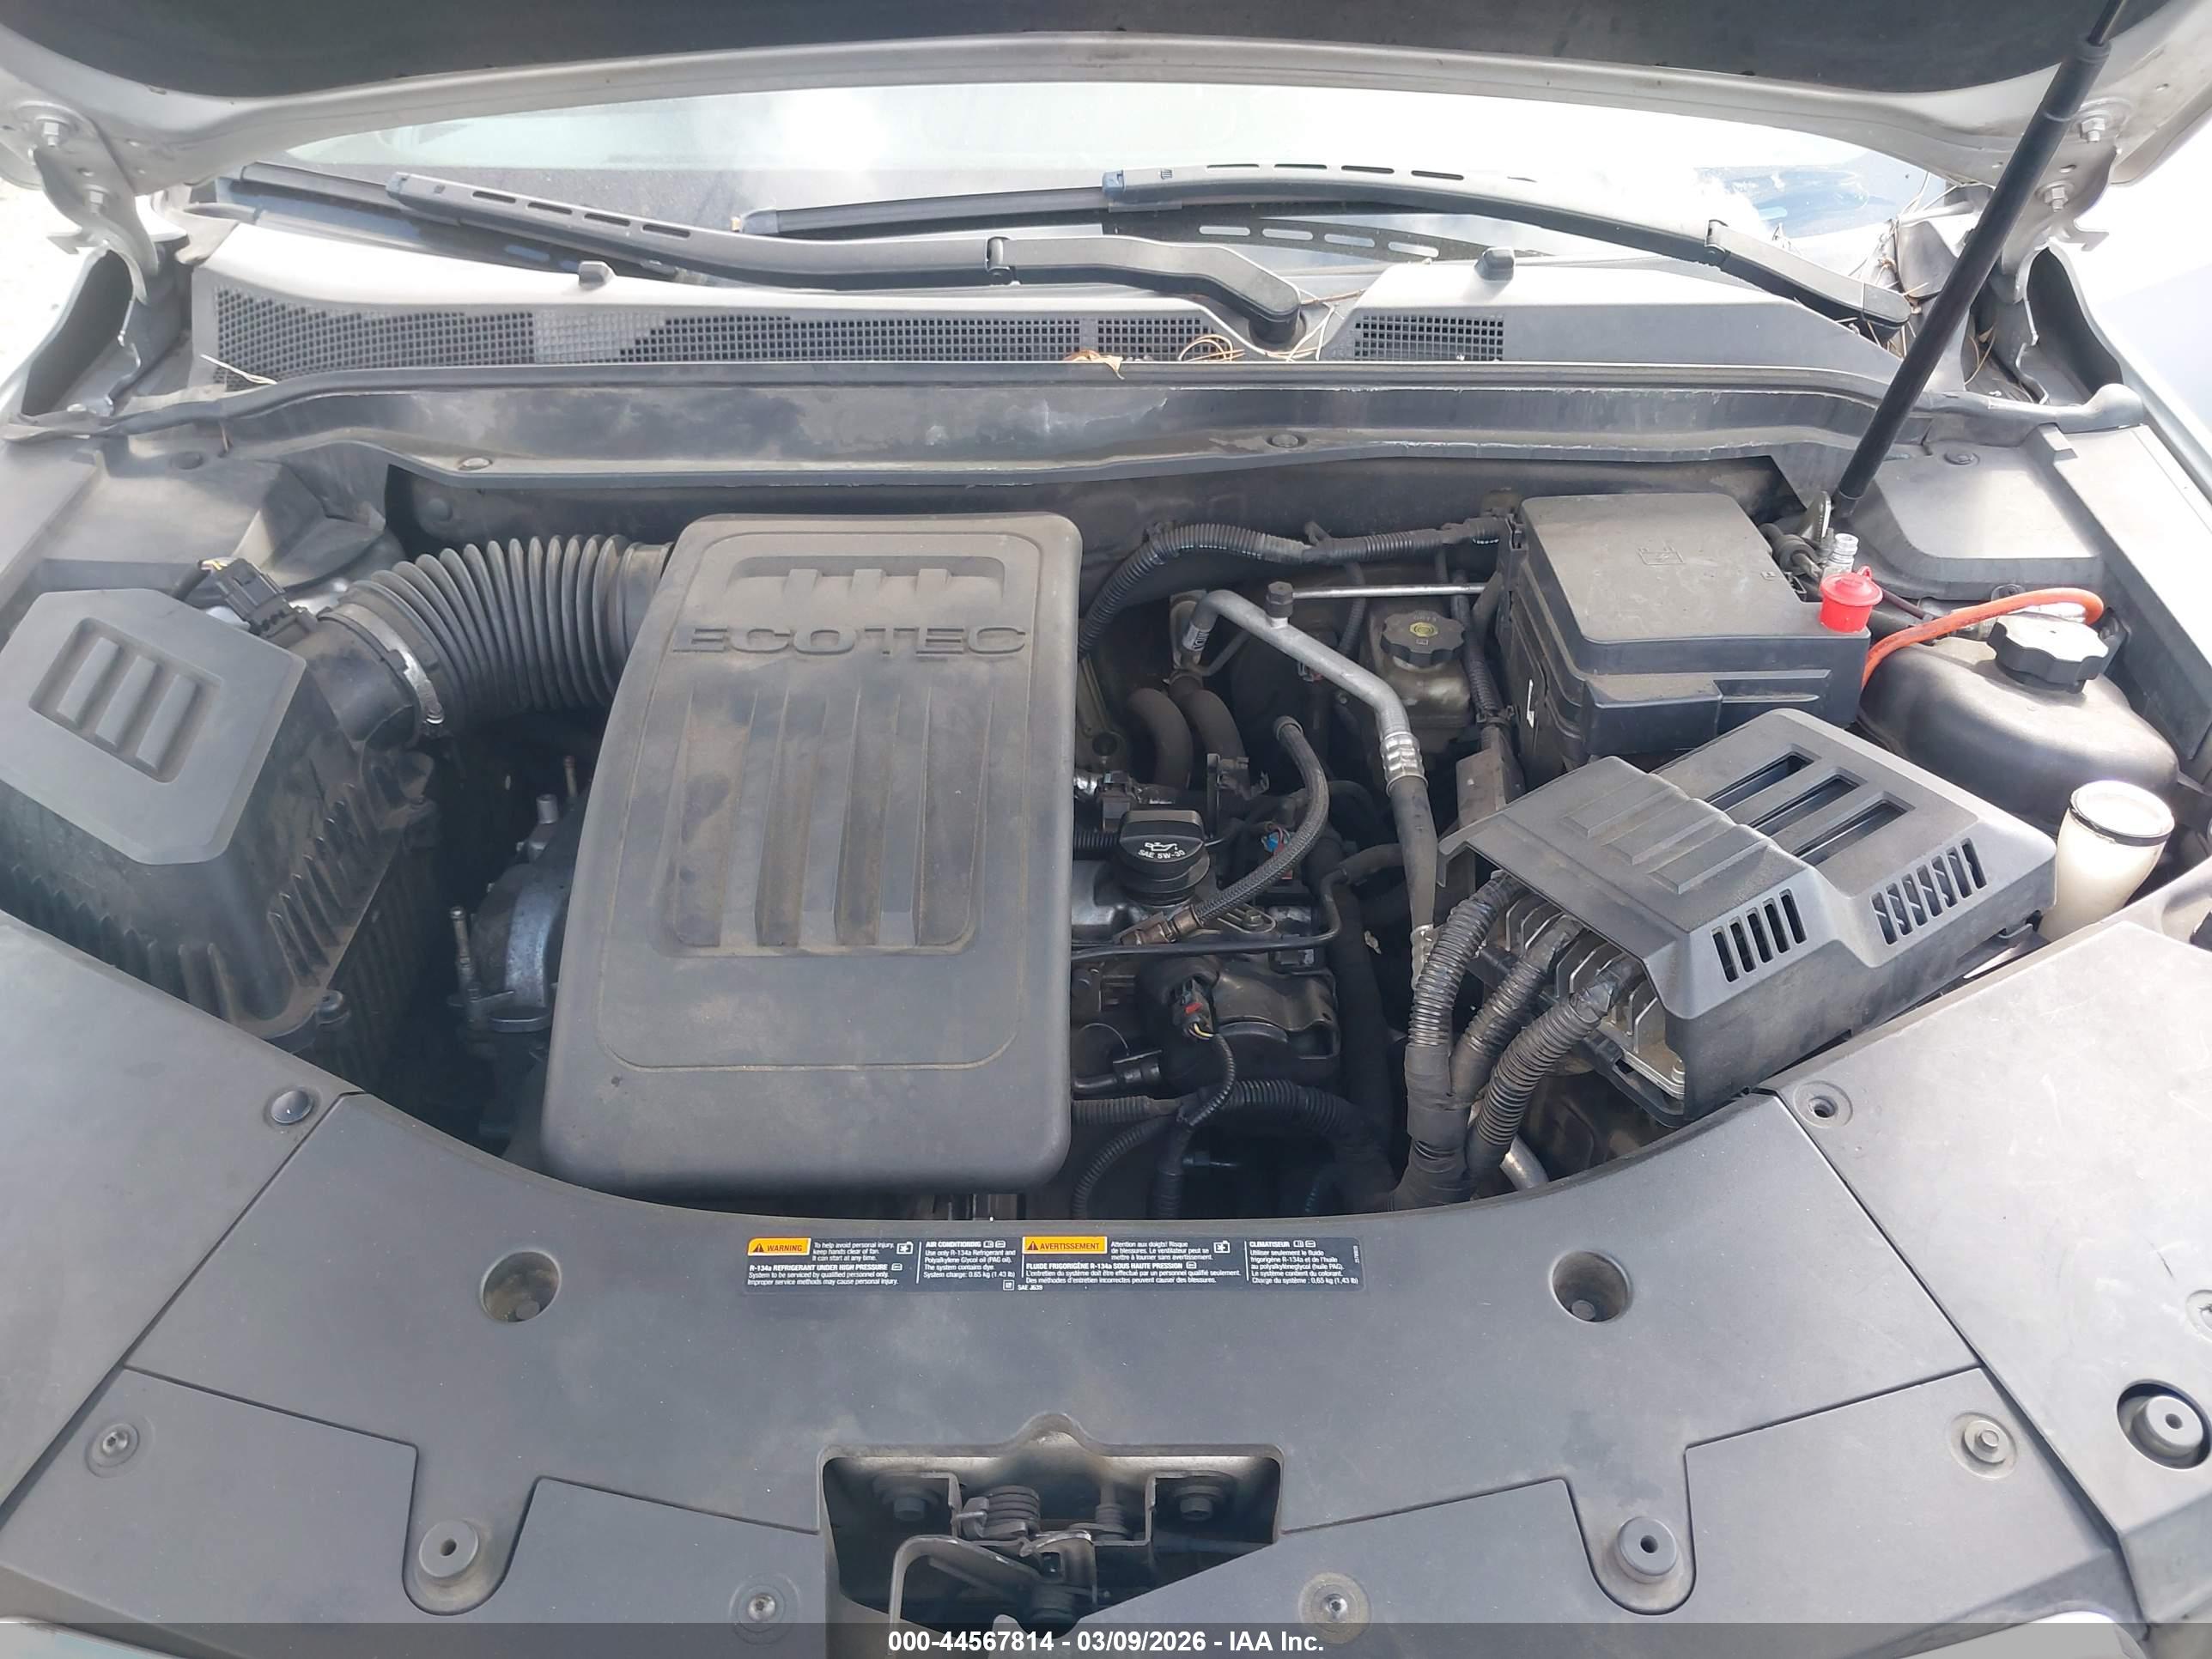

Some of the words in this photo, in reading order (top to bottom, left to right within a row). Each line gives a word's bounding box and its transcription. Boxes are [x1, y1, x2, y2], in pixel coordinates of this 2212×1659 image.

[672, 628, 1027, 655] ECOTEC
[1138, 849, 1155, 858] SAE
[1157, 850, 1185, 859] 5W-30
